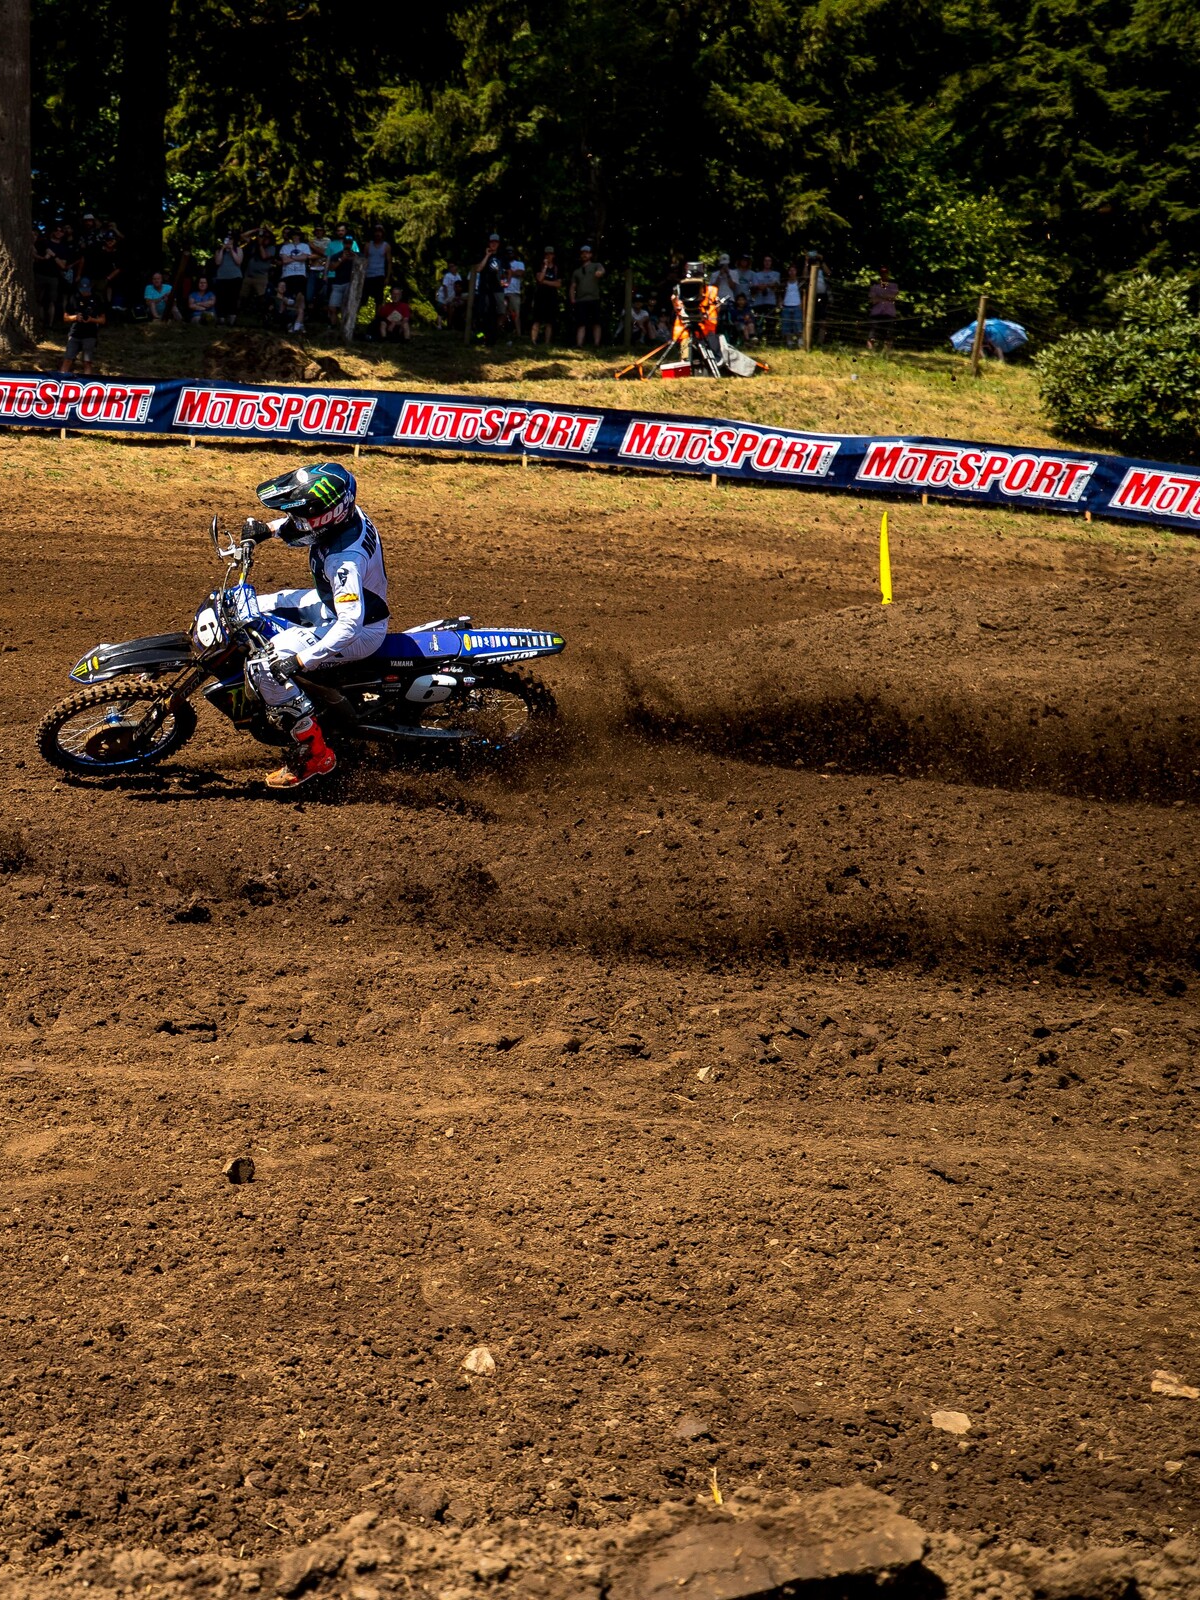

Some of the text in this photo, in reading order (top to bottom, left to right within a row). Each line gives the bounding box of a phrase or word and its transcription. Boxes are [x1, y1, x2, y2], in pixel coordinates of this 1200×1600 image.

[312, 490, 355, 528] 100%
[486, 651, 538, 666] DUNLOP
[404, 673, 458, 703] 6
